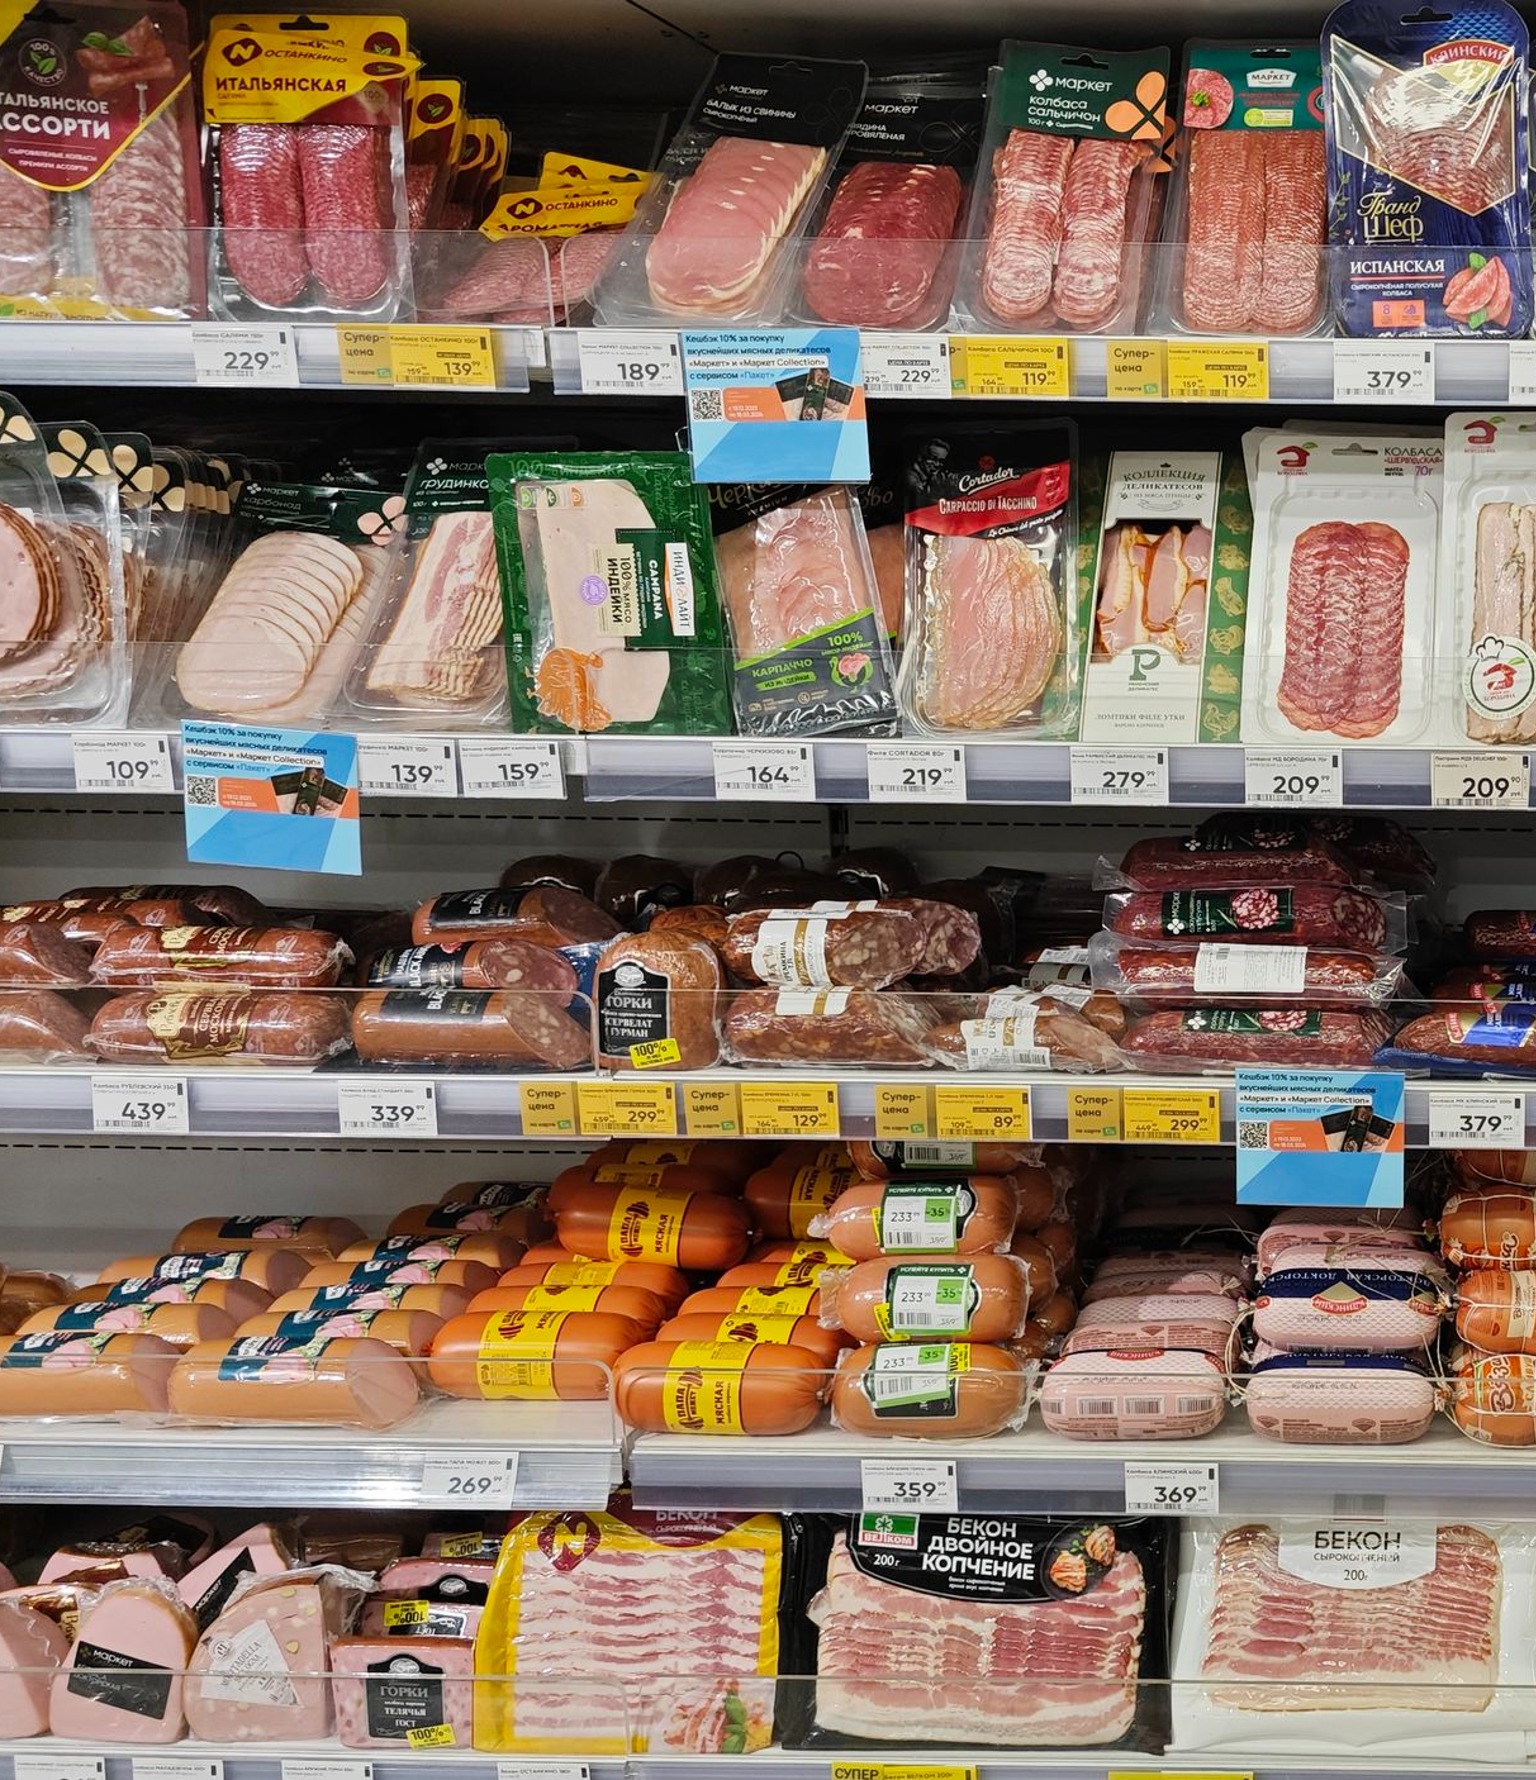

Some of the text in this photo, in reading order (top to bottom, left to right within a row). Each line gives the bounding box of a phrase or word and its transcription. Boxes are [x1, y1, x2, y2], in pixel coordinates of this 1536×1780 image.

[265, 49, 347, 63] ОСТАНКИНО
[216, 77, 346, 93] ИТАЛЬЯНСКАЯ
[1055, 77, 1113, 94] маркет
[1252, 72, 1291, 82] МАРКЕТ
[865, 103, 919, 116] маркет
[1030, 96, 1087, 108] колбаса
[1028, 106, 1101, 123] сальчичон
[0, 113, 110, 140] ССОРТИ
[545, 198, 618, 212] ОСТАНКИНО
[1364, 216, 1424, 242] Шеф
[1351, 259, 1445, 274] ИСПАНСКАЯ
[345, 332, 385, 346] Супер-
[685, 334, 785, 345] Кешбэк 10% за покупку
[346, 348, 374, 359] цена
[688, 346, 831, 355] вкуснейших мясных деликатесов
[224, 352, 269, 370] 229
[444, 361, 471, 376] 139
[689, 358, 729, 369] «Маркет»
[739, 358, 774, 369] «Маркет
[776, 357, 826, 367] Collection»
[617, 363, 659, 381] 189
[696, 371, 738, 381] сервисом
[740, 370, 775, 381] «Пакет»
[1367, 370, 1412, 389] 379
[1222, 375, 1246, 388] 119
[1384, 447, 1443, 457] КОЛБАСА
[958, 467, 1020, 494] Cortador
[939, 497, 985, 515] CARPACCIO
[997, 495, 1037, 511] TACCHINO
[607, 558, 623, 623] ИНДЕЙКИ
[649, 559, 663, 620] CAMPANA
[828, 631, 863, 646] 100%
[752, 657, 813, 678] КАРПАЧЧО
[106, 760, 148, 779] 109
[746, 766, 789, 783] 164
[902, 767, 942, 786] 219
[1102, 771, 1145, 788] 279
[1462, 777, 1509, 798] 209
[122, 1101, 166, 1121] 439
[628, 1110, 657, 1124] 299
[792, 1114, 818, 1127] 129
[994, 1115, 1012, 1128] 89
[448, 1476, 492, 1495] 269
[1154, 1486, 1197, 1504] 369
[947, 1517, 1017, 1538] БЕКОН
[929, 1536, 1033, 1560] ДВОЙНОЕ
[1314, 1530, 1401, 1550] БЕКОН
[922, 1555, 1035, 1581] КОПЧЕНИЕ
[380, 1683, 429, 1699] ГОРКИ
[384, 1707, 426, 1718] ТЕЛЯЧЬЯ
